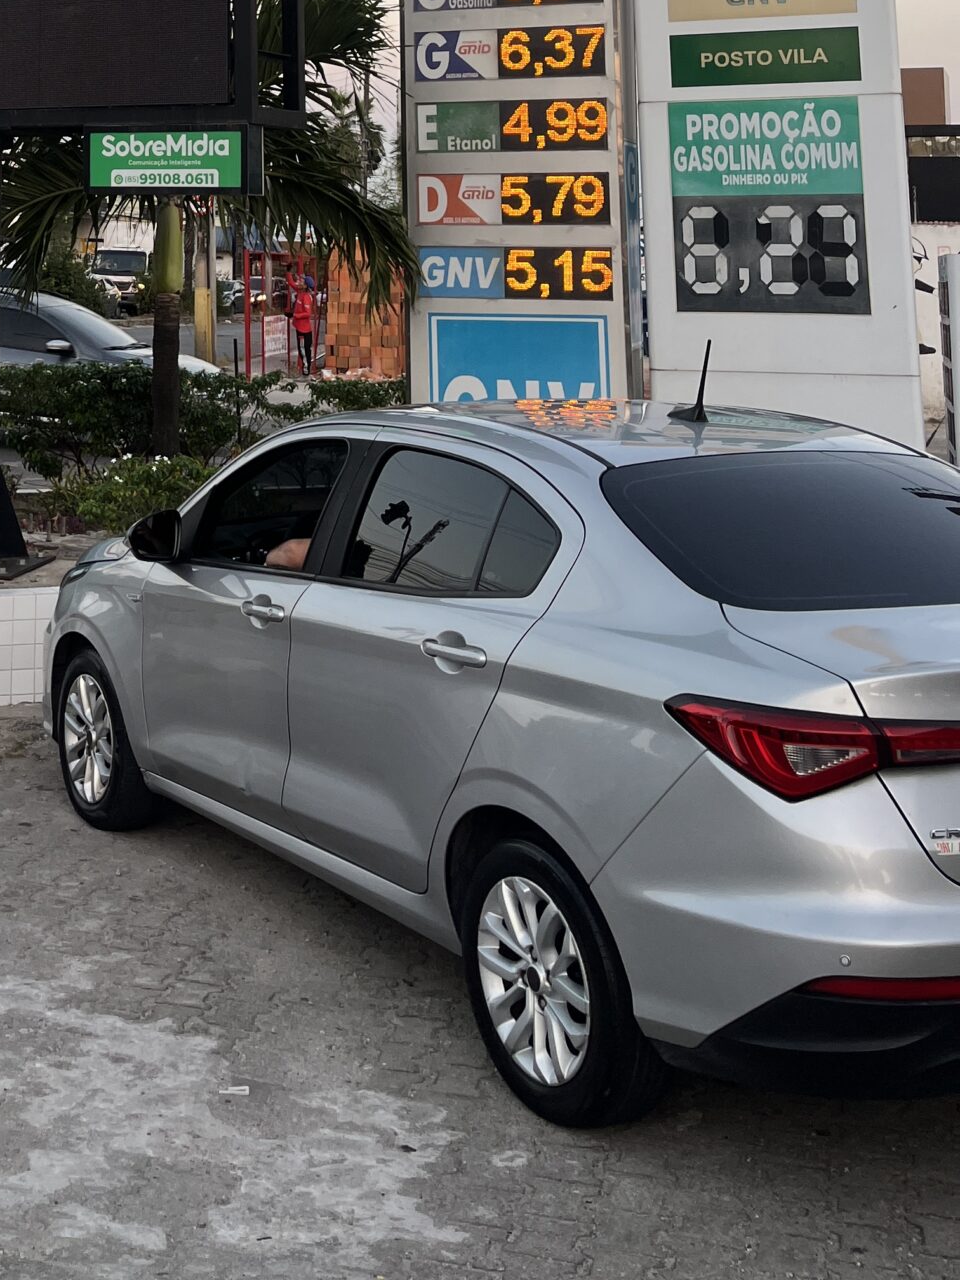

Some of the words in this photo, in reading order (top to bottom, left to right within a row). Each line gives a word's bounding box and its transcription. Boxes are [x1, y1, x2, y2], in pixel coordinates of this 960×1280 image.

[417, 33, 450, 80] G
[458, 40, 491, 55] GRID
[500, 27, 605, 77] 6,37
[700, 50, 773, 68] POSTO
[778, 48, 828, 64] VILA
[417, 104, 439, 151] E
[447, 134, 496, 151] Etanol
[502, 101, 607, 150] 4,99
[686, 102, 842, 143] PROMOÇÃO
[101, 133, 229, 157] SobreMidia
[674, 144, 777, 172] GASOLINA
[781, 142, 858, 169] COMUM
[418, 176, 448, 223] D
[462, 186, 495, 200] GRID
[501, 176, 604, 224] 5,79
[722, 174, 771, 186] DINHEIRO
[773, 174, 789, 185] OU
[791, 173, 808, 185] PIX
[421, 256, 500, 289] GNV
[506, 250, 613, 298] 5,15
